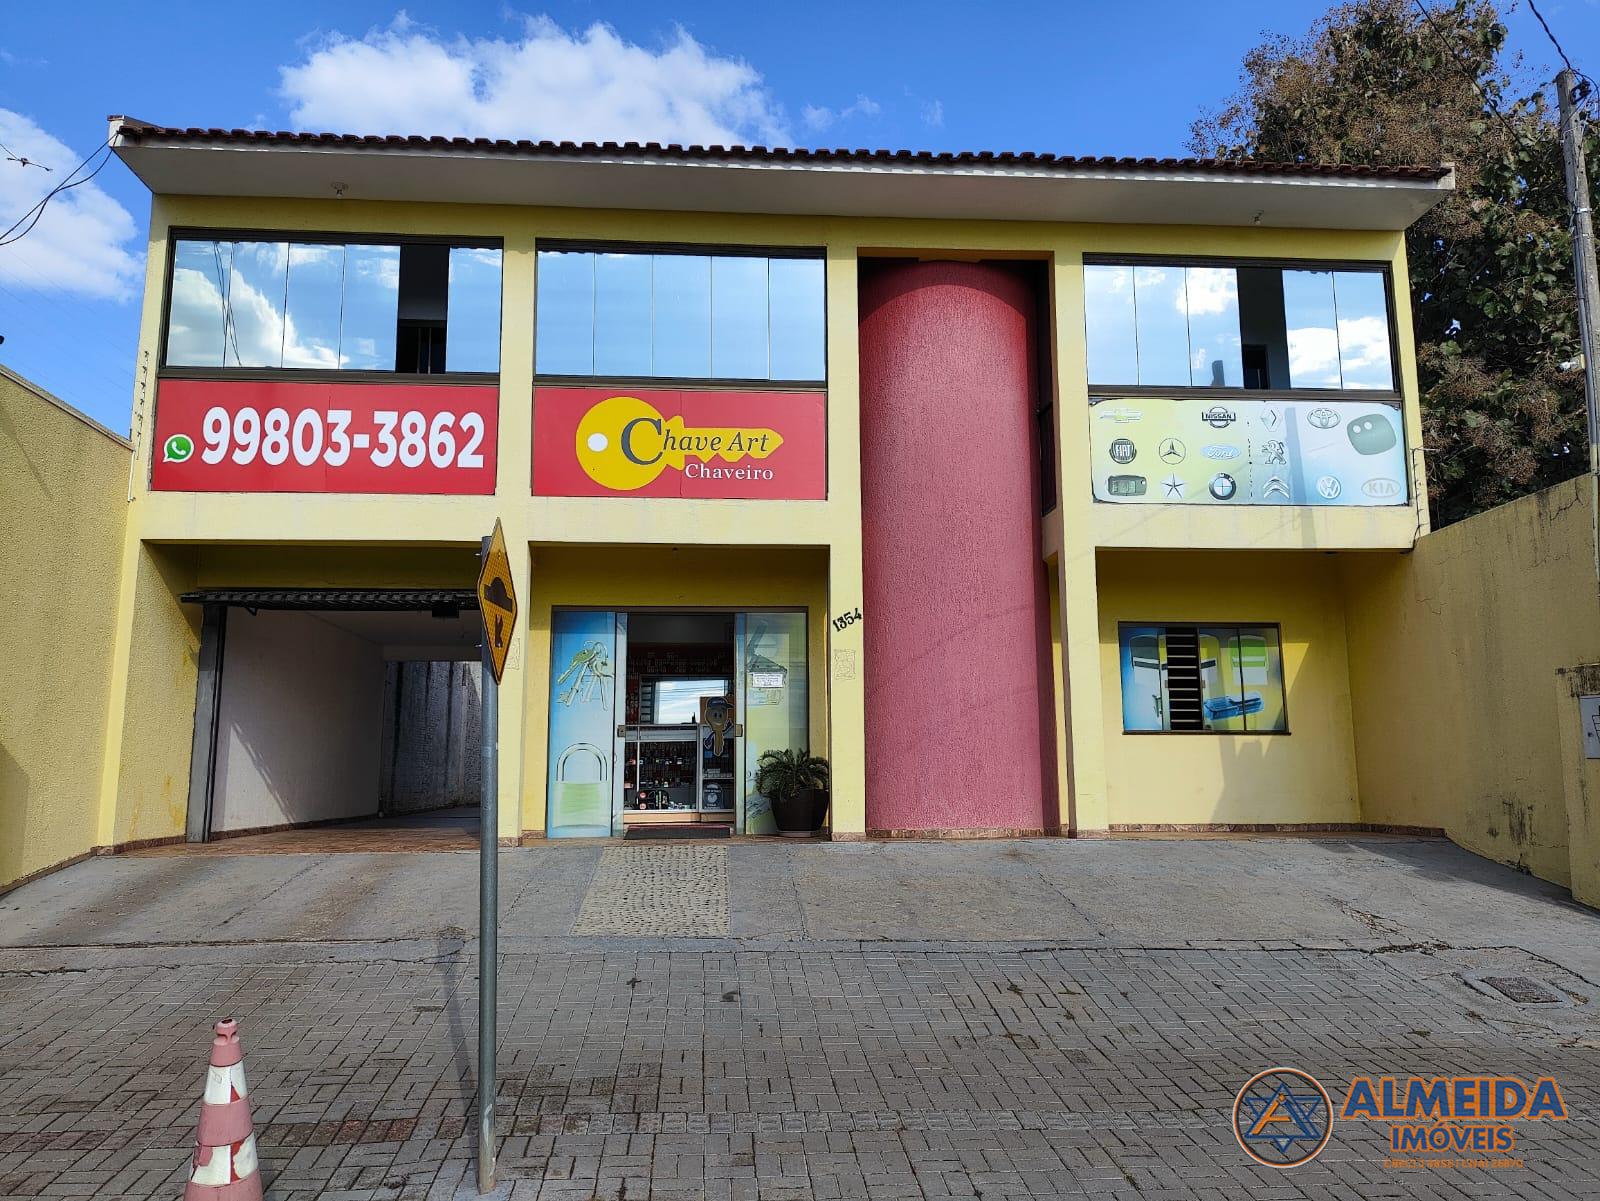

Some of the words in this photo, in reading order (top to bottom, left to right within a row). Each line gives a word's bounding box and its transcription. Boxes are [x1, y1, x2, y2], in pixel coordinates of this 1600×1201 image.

[201, 406, 485, 469] 99803-3862
[620, 417, 722, 466] Chave
[728, 431, 769, 452] Art
[1115, 444, 1131, 457] FIAT
[685, 463, 774, 481] Chaveiro
[1368, 482, 1396, 494] KIA
[832, 607, 862, 632] 1354
